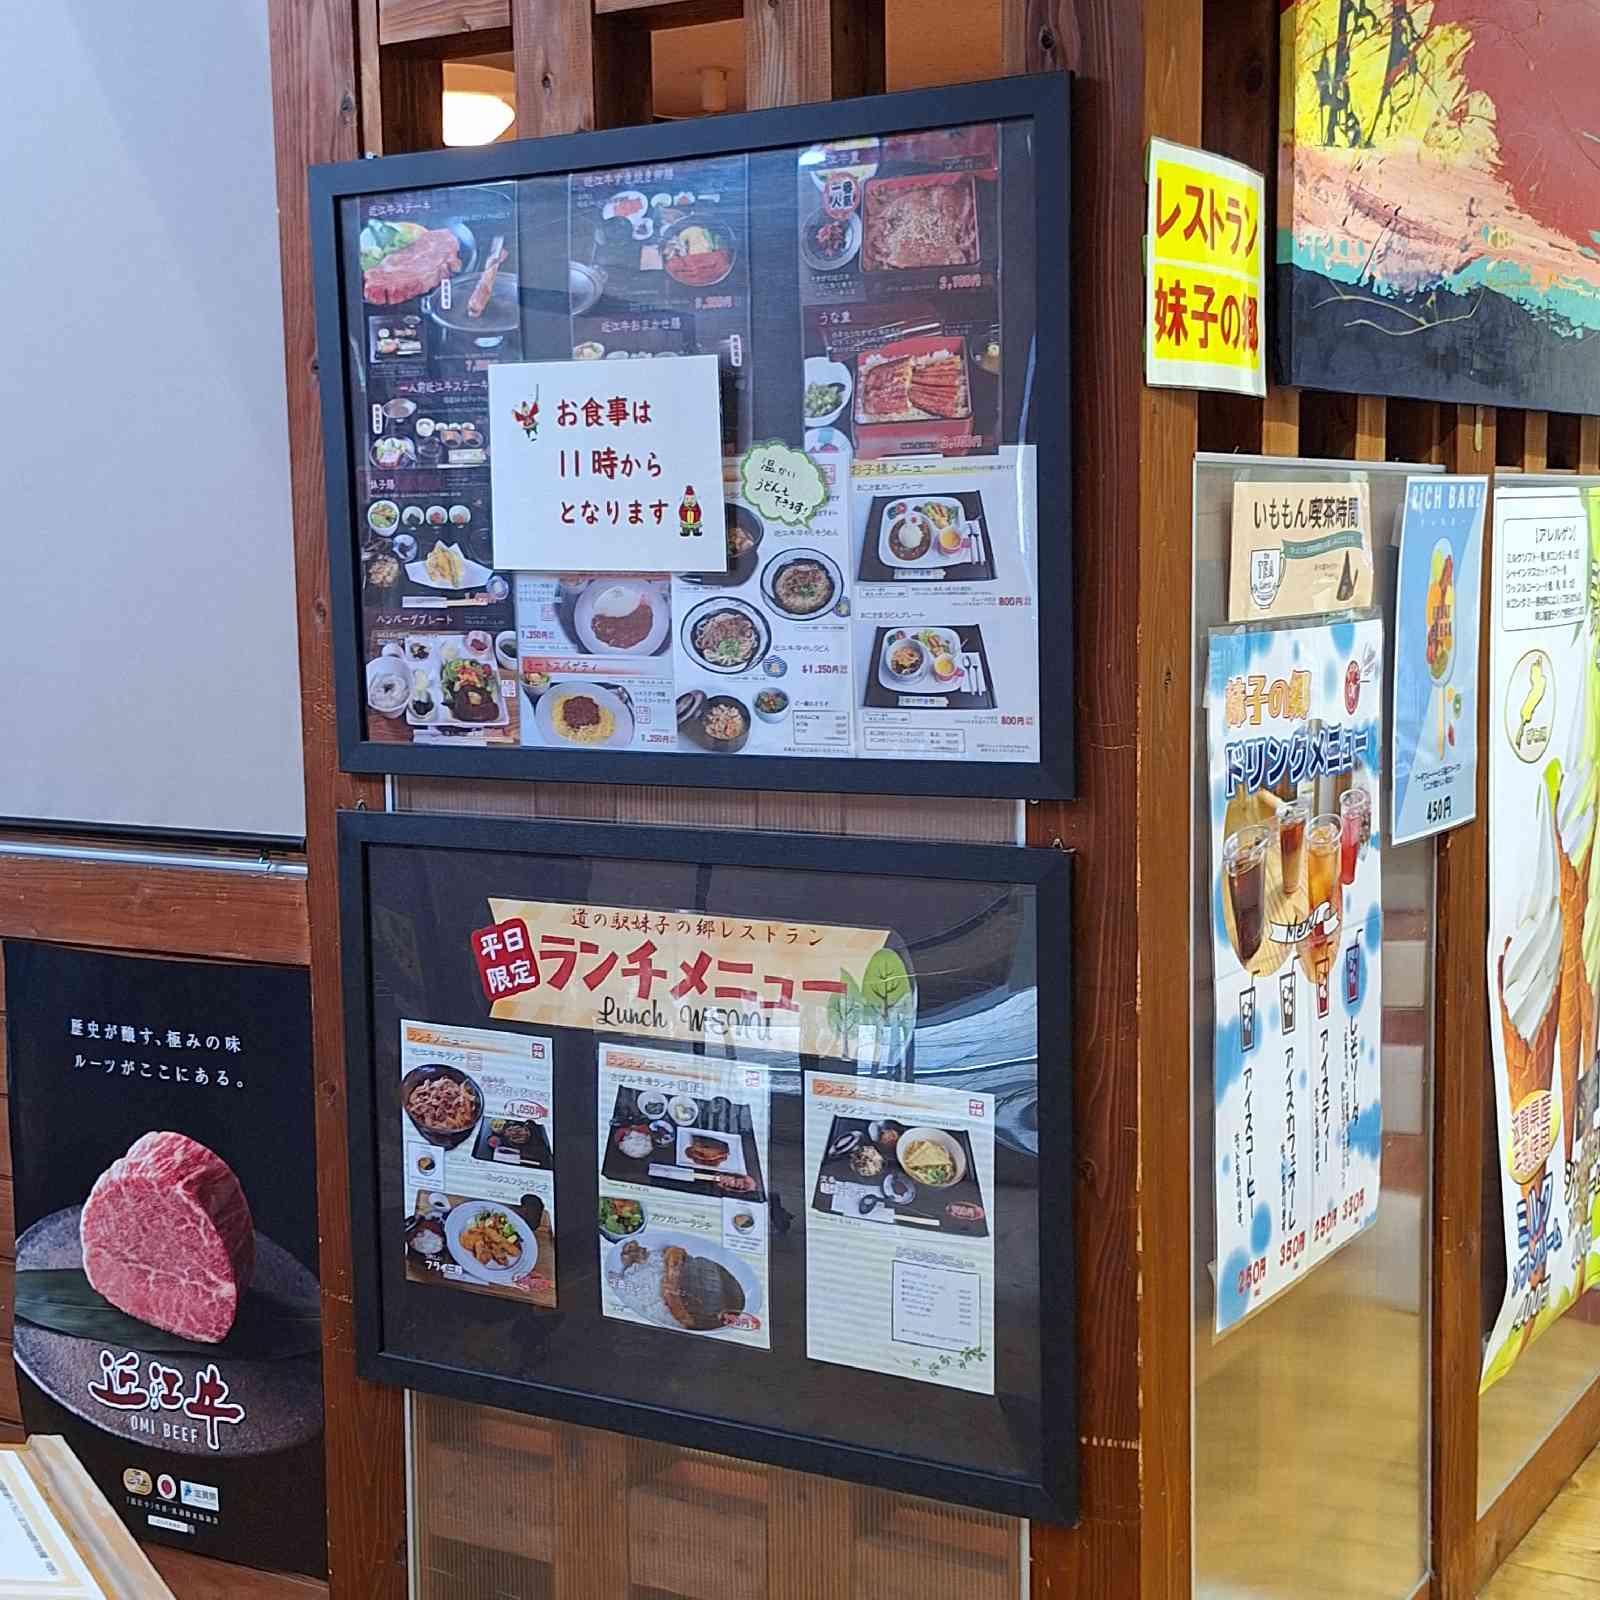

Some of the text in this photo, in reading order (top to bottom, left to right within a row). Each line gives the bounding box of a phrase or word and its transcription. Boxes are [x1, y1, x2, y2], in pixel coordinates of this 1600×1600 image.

[1156, 177, 1258, 258] レストラン
[1154, 276, 1259, 358] 妹子の郷
[556, 396, 652, 427] お食事は
[560, 446, 662, 480] 11時から
[560, 500, 669, 525] となります
[1253, 496, 1359, 530] いももん喫茶時間
[1225, 722, 1370, 799] ドリンクメニュー
[480, 927, 525, 960] 平日
[571, 908, 824, 948] 道の駅妹子の郷レストラン
[487, 959, 536, 993] 限定
[539, 933, 847, 1012] ランチメニュー
[596, 996, 667, 1027] Lunch
[74, 1054, 244, 1088] ルーツがここにある。
[1320, 1028, 1331, 1163] アイスティー
[1243, 1067, 1256, 1220] アイスコーヒー
[1285, 1047, 1297, 1232] アイスカフェオーレ
[88, 1350, 246, 1449] 近江牛
[130, 1415, 199, 1444] OMI BEEF
